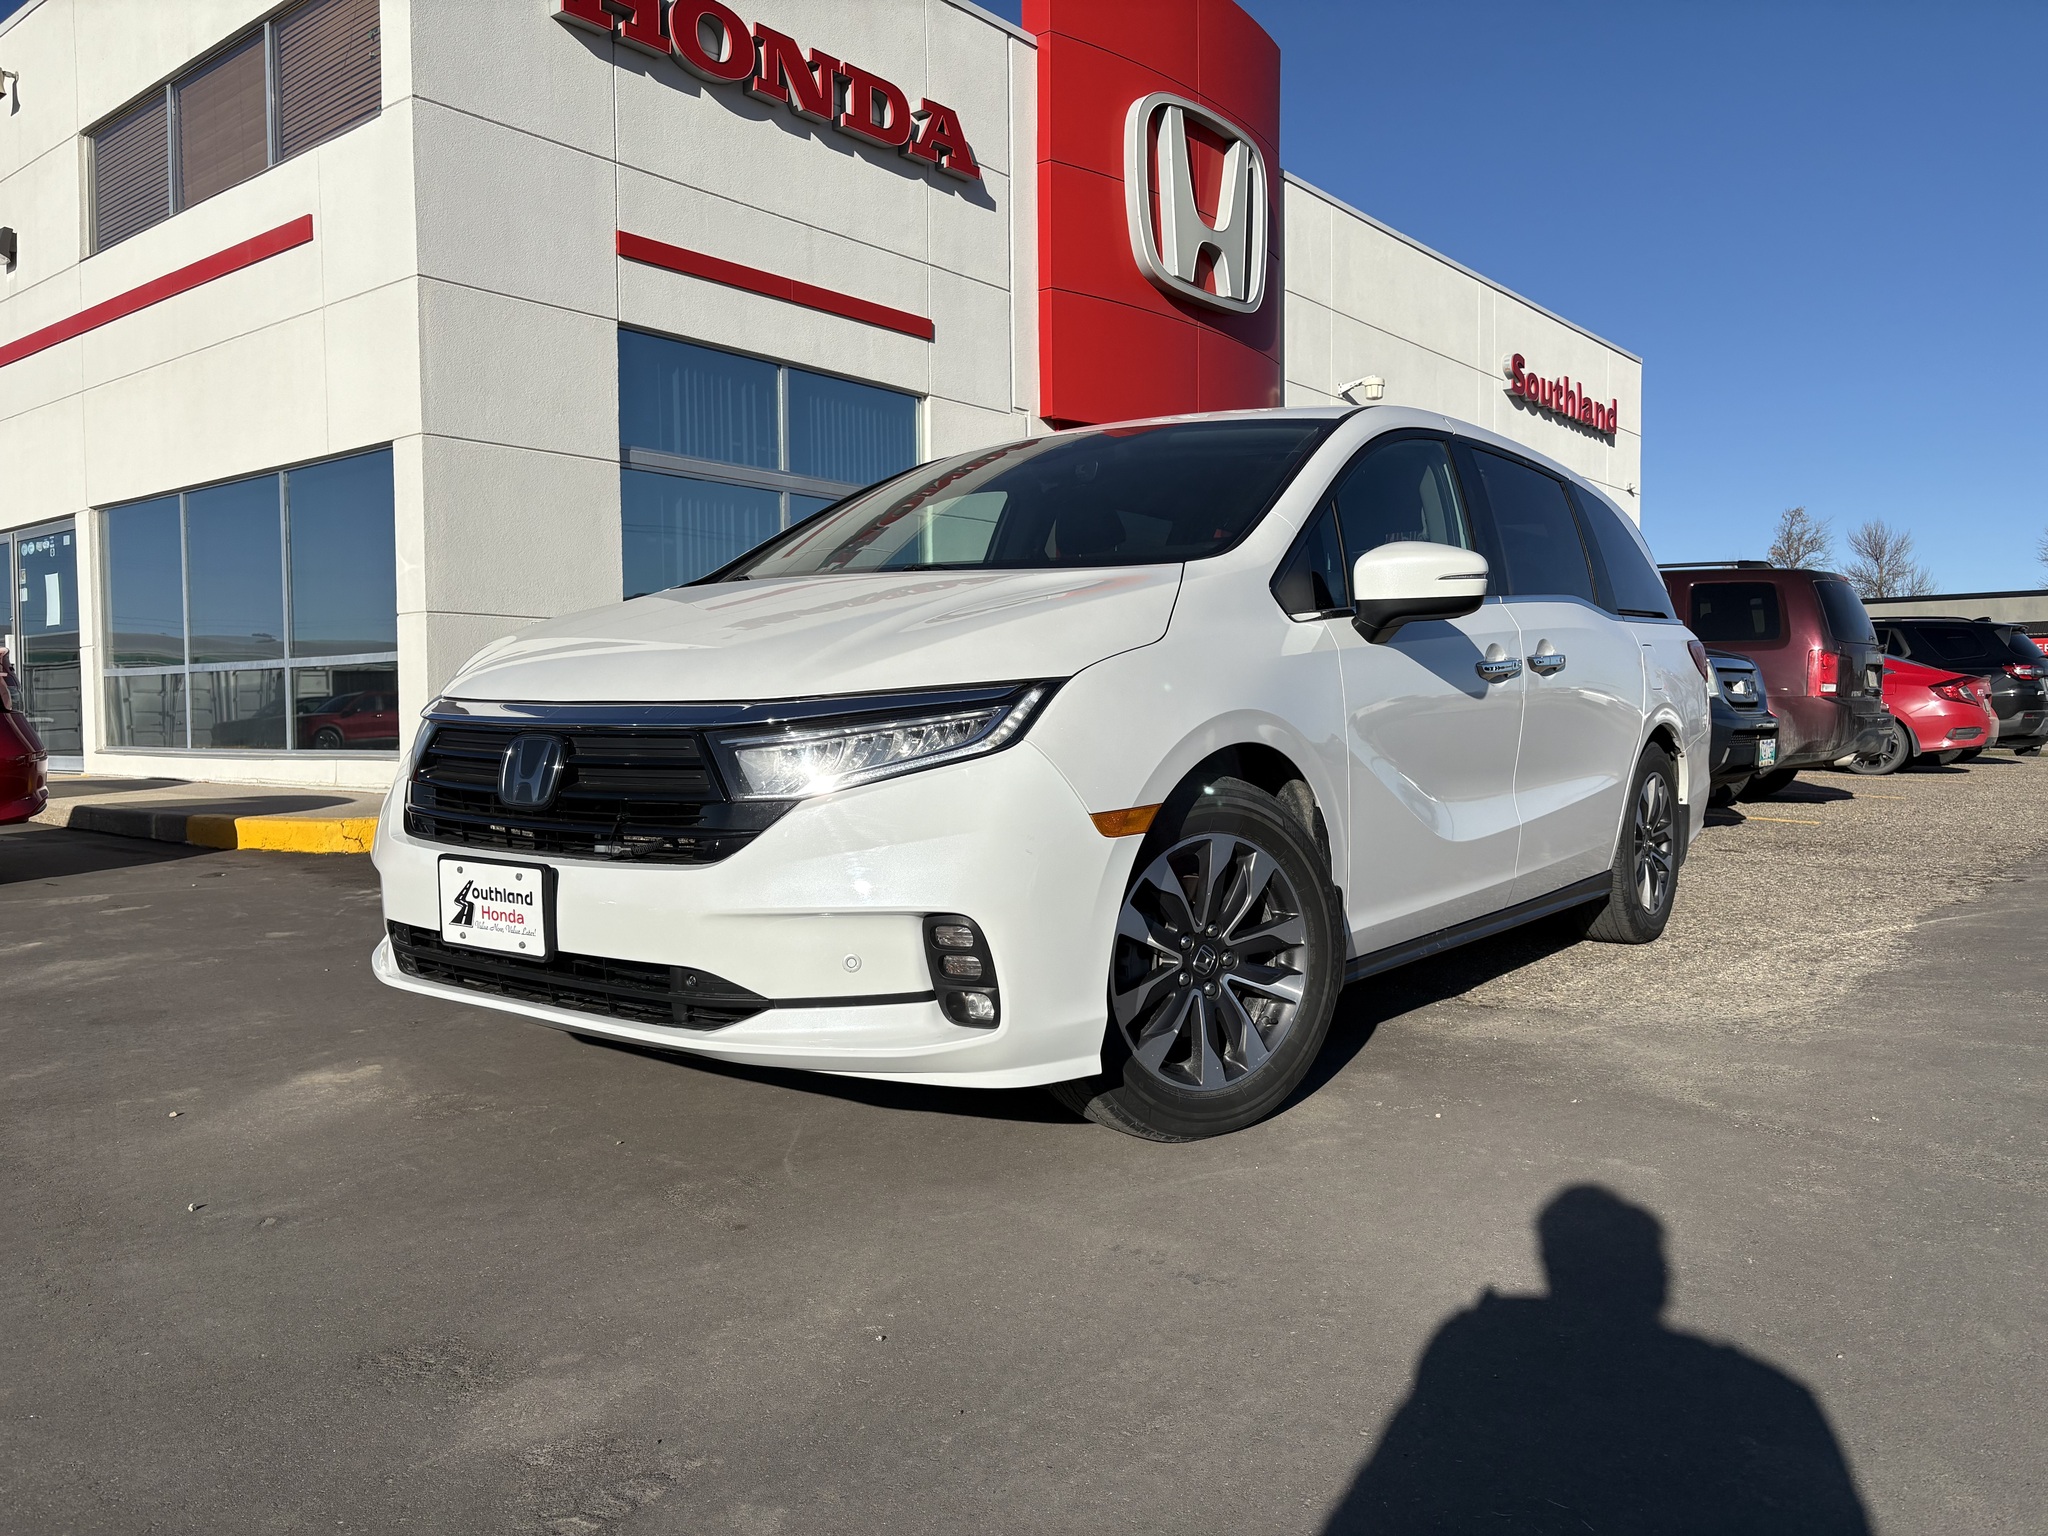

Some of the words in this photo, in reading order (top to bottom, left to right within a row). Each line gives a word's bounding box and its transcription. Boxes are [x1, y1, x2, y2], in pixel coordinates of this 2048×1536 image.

[1511, 352, 1617, 434] Southland
[481, 905, 525, 924] Honda
[474, 920, 489, 931] Value
[505, 924, 521, 935] Value
